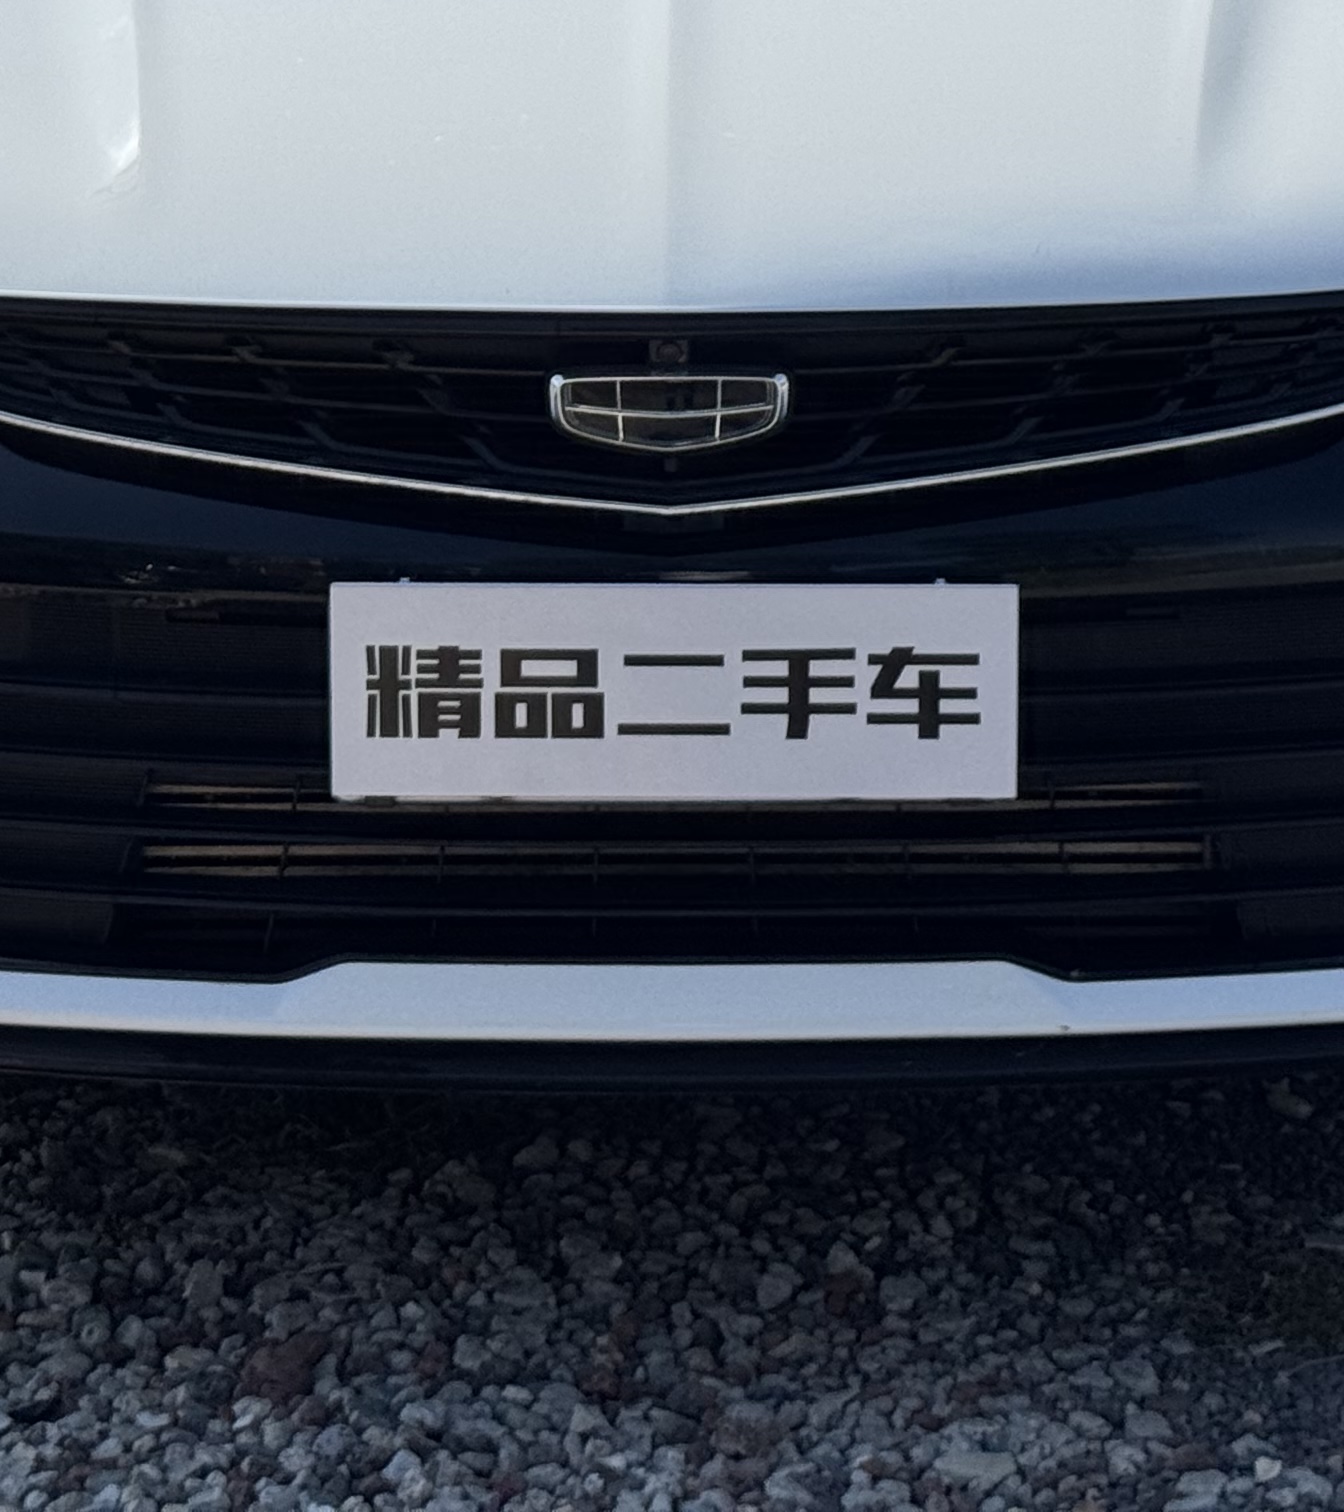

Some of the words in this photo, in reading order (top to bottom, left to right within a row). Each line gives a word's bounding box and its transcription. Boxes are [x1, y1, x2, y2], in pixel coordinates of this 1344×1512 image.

[365, 644, 981, 741] 精品二手车
